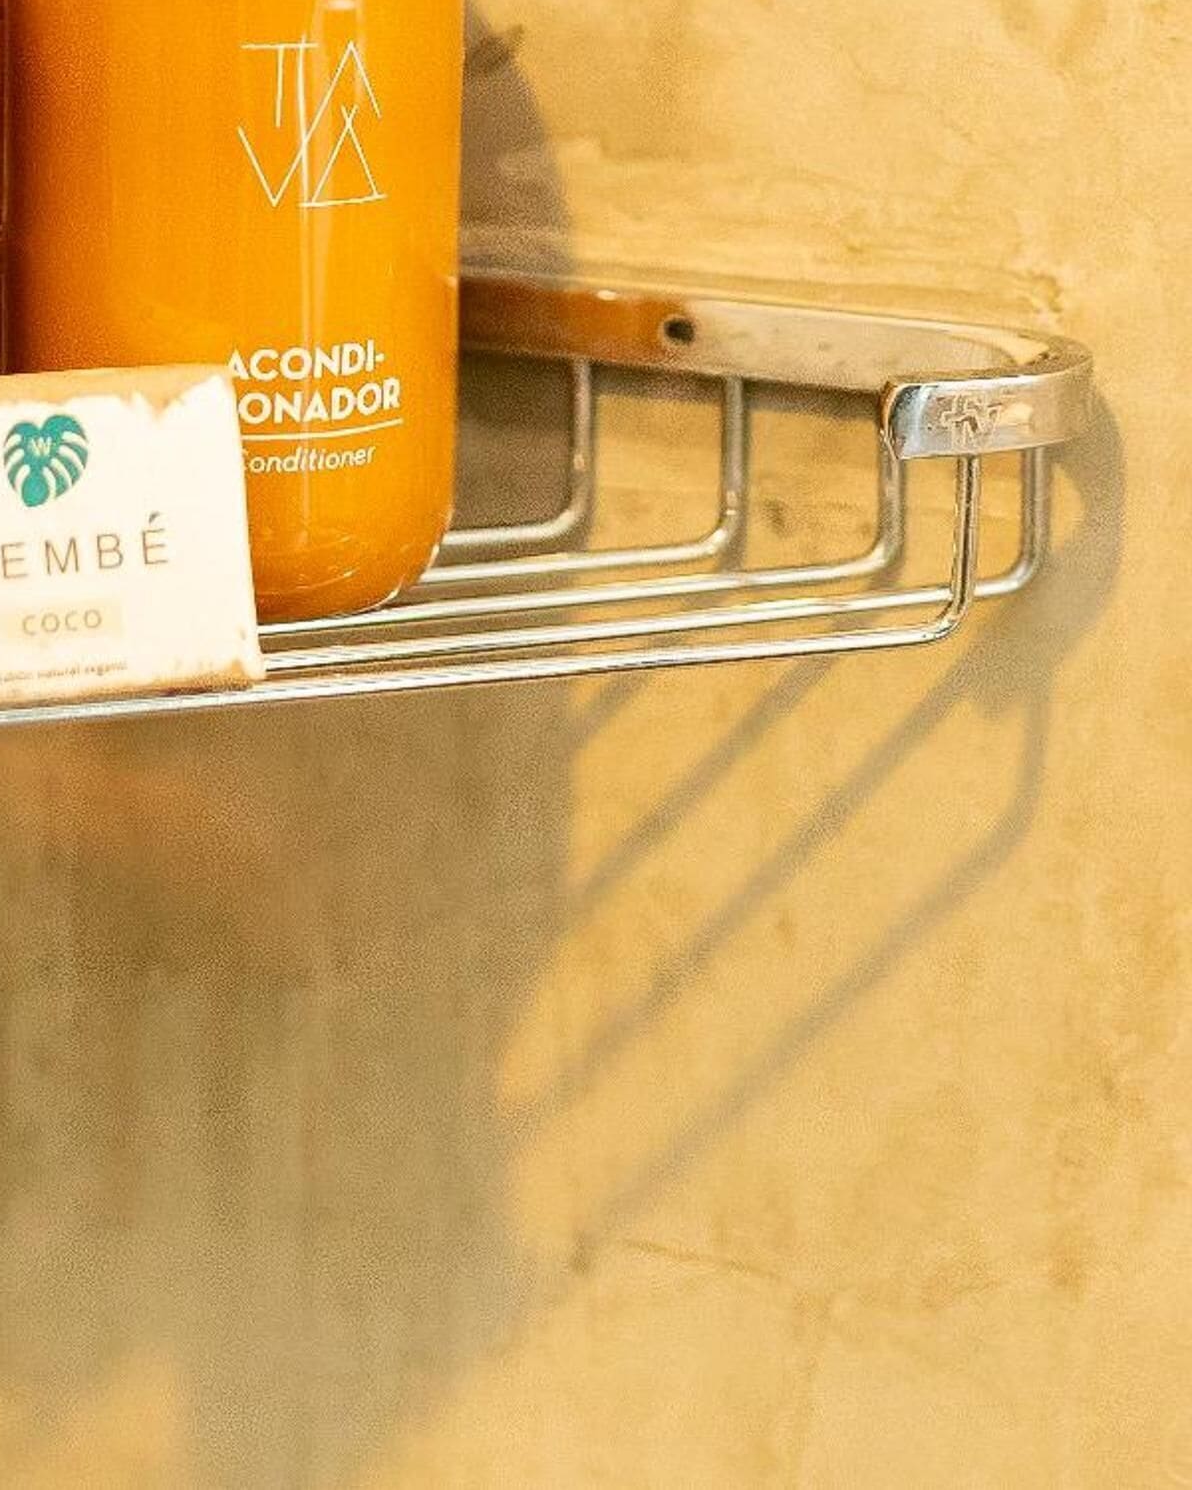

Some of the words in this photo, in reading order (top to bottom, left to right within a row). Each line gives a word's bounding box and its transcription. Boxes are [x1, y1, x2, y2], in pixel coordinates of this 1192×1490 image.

[227, 339, 385, 381] ACONDI-
[238, 377, 400, 424] ONADOR
[22, 609, 102, 636] COCO
